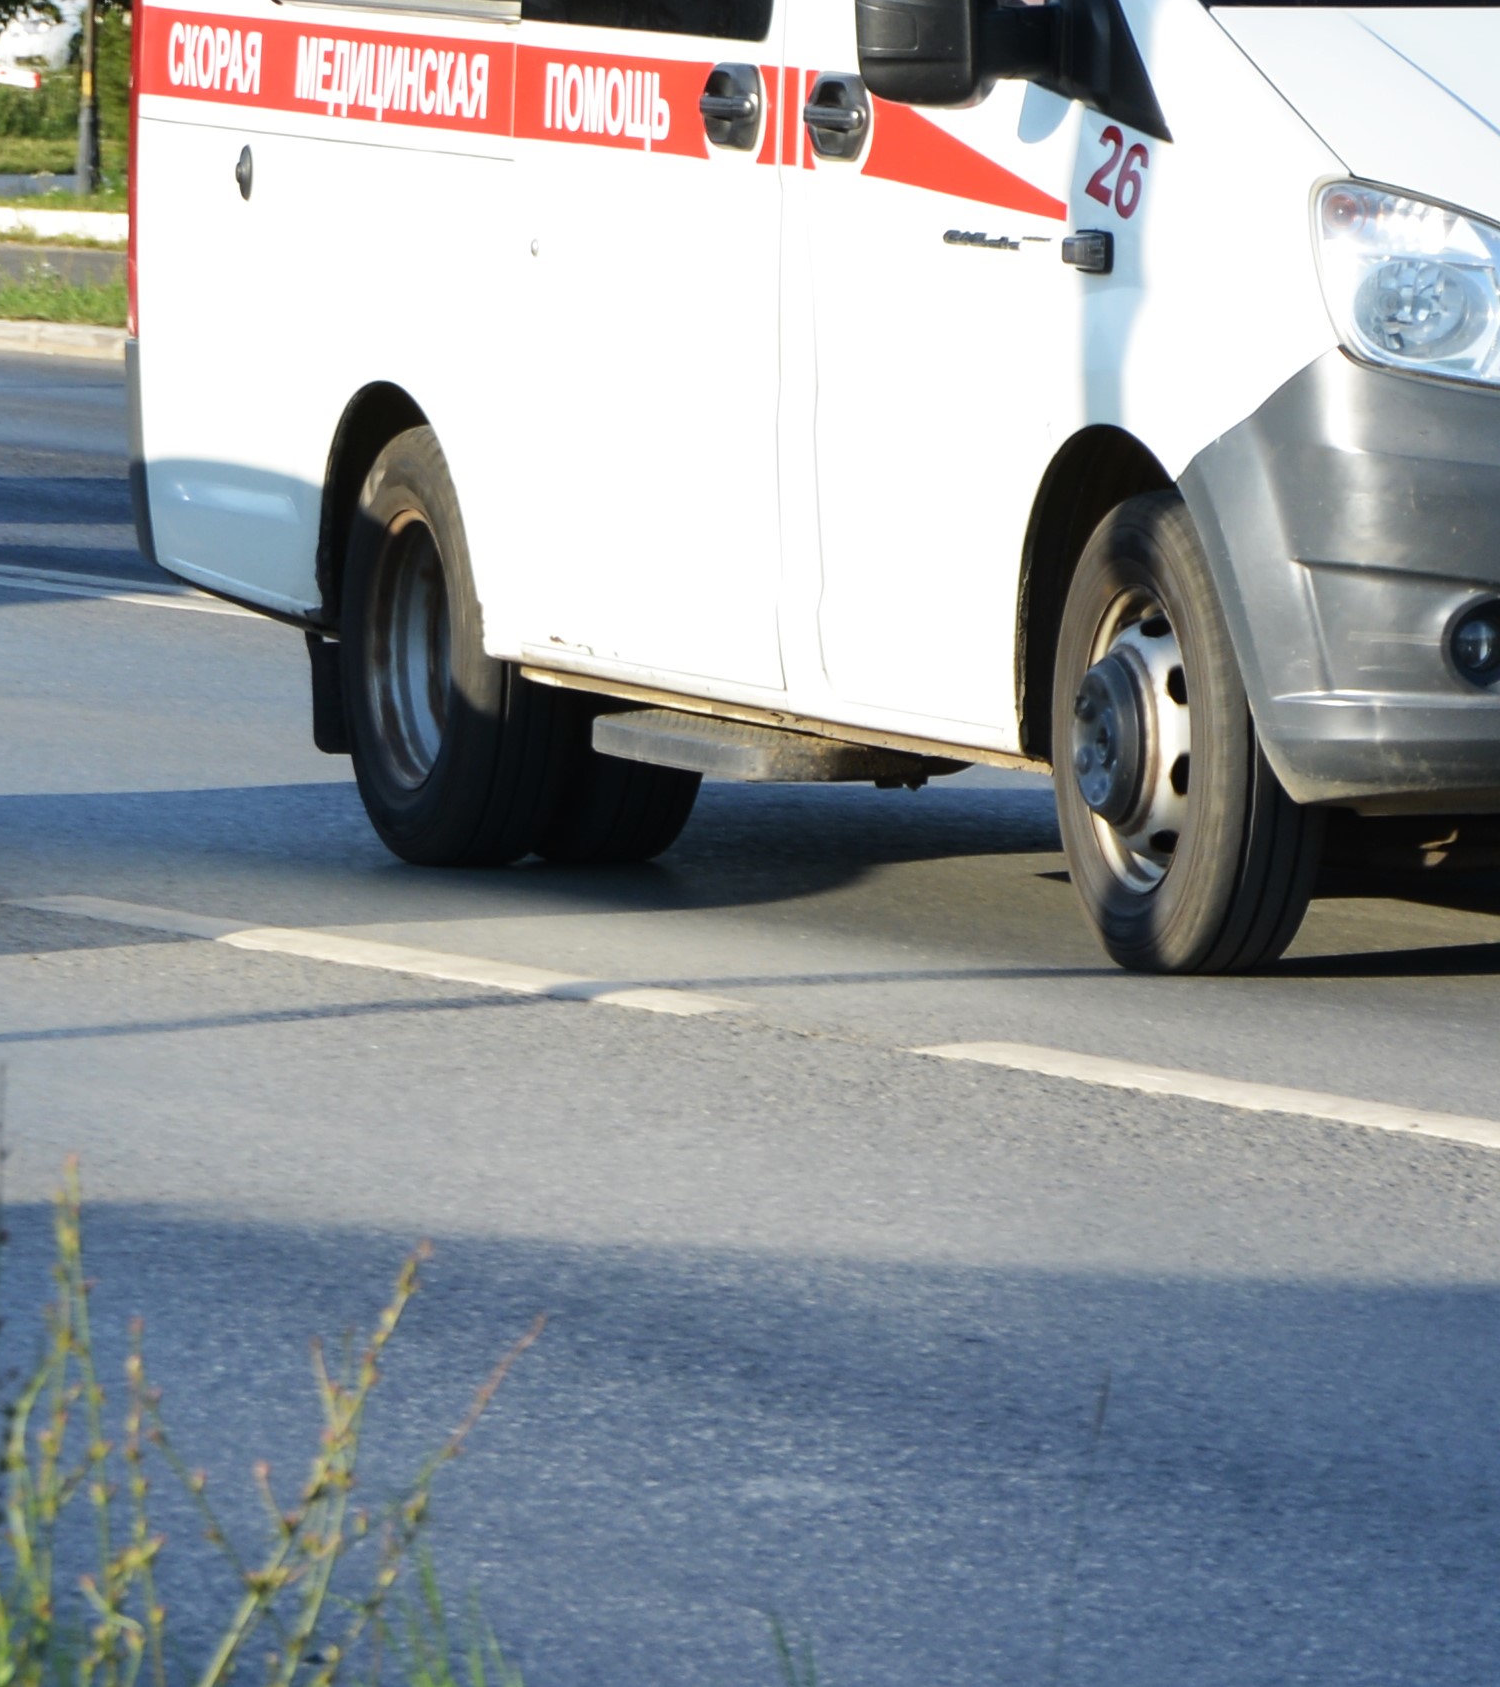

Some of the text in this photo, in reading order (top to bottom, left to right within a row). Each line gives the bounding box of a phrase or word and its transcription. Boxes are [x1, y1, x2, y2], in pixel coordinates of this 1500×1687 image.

[167, 20, 672, 153] СКОРАЯ МЕДИЦИНСКАЯ ПОМОЩЬ
[1085, 125, 1150, 220] 26
